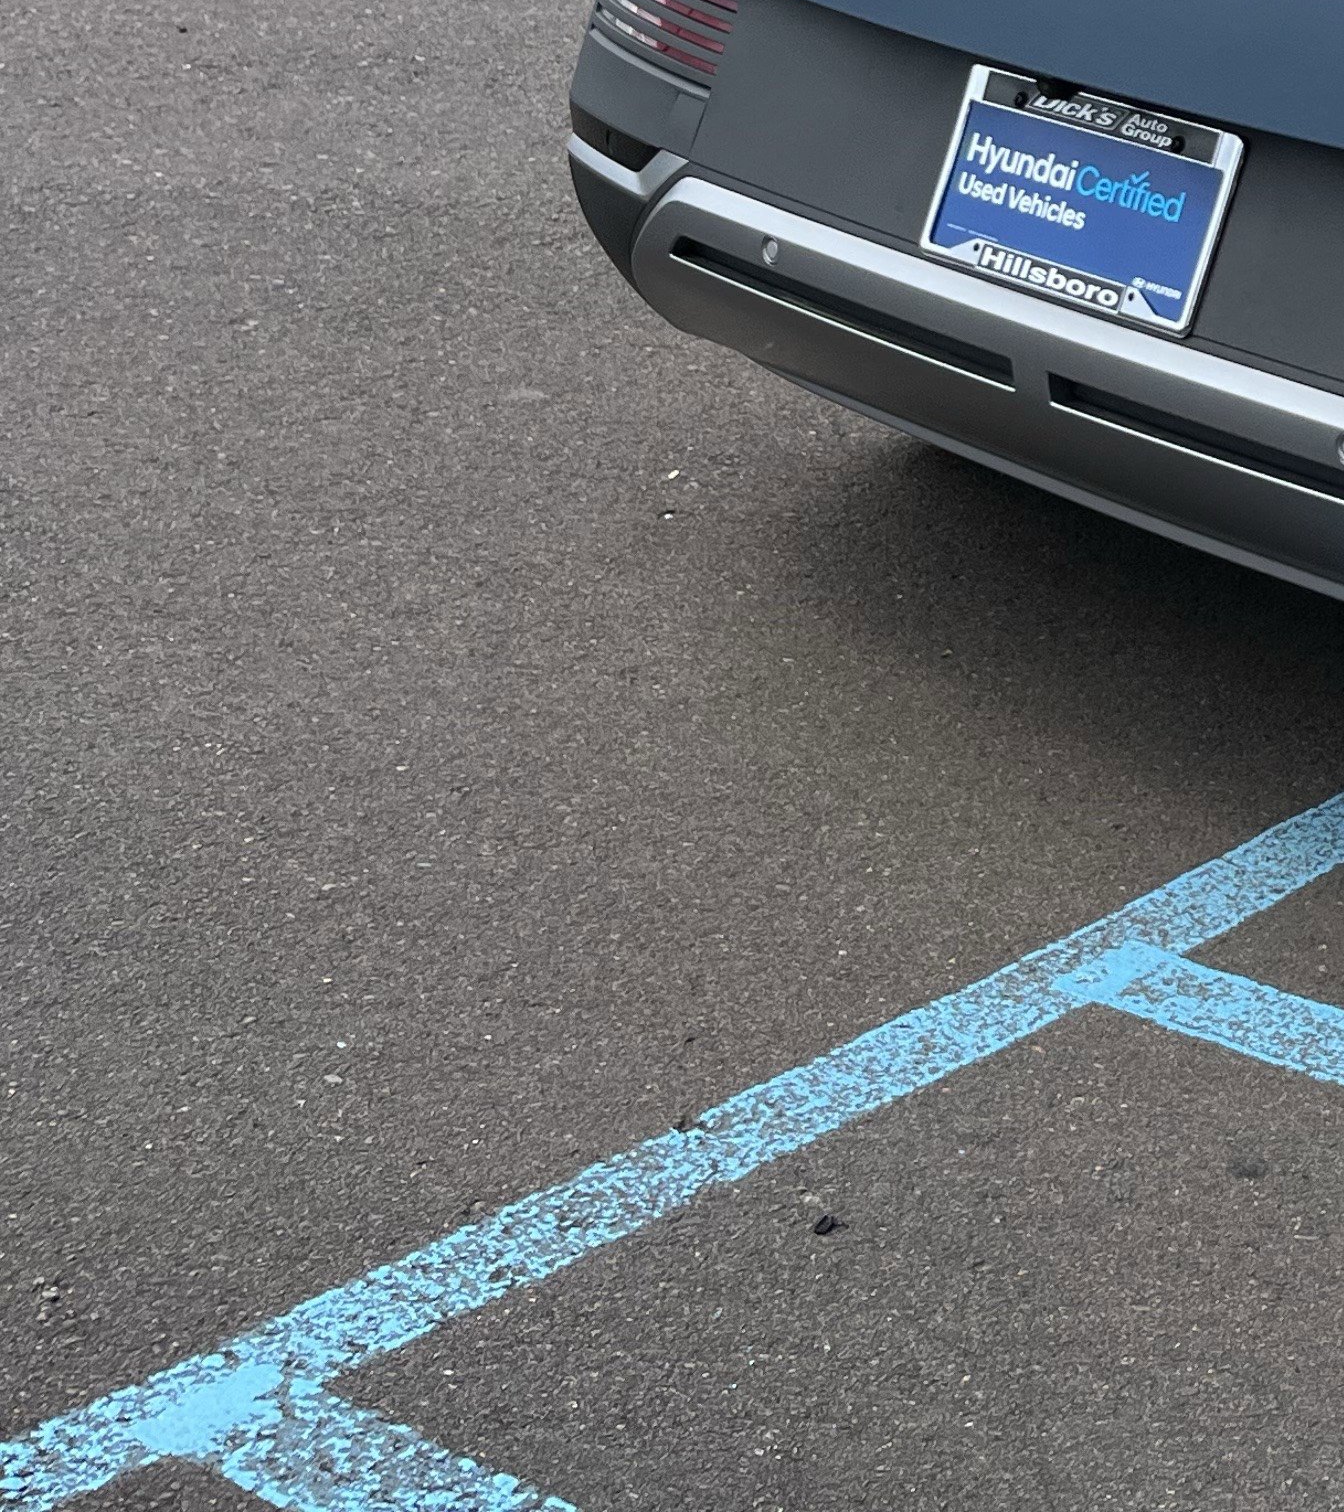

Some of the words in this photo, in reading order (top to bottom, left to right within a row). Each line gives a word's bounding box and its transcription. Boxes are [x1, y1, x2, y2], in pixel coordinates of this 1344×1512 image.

[1120, 123, 1173, 148] Group
[1127, 113, 1169, 134] Auto
[966, 132, 1080, 191] Hyundai
[957, 171, 1008, 206] Used
[1007, 185, 1087, 231] Vehicles
[980, 246, 1119, 307] Hillsboro
